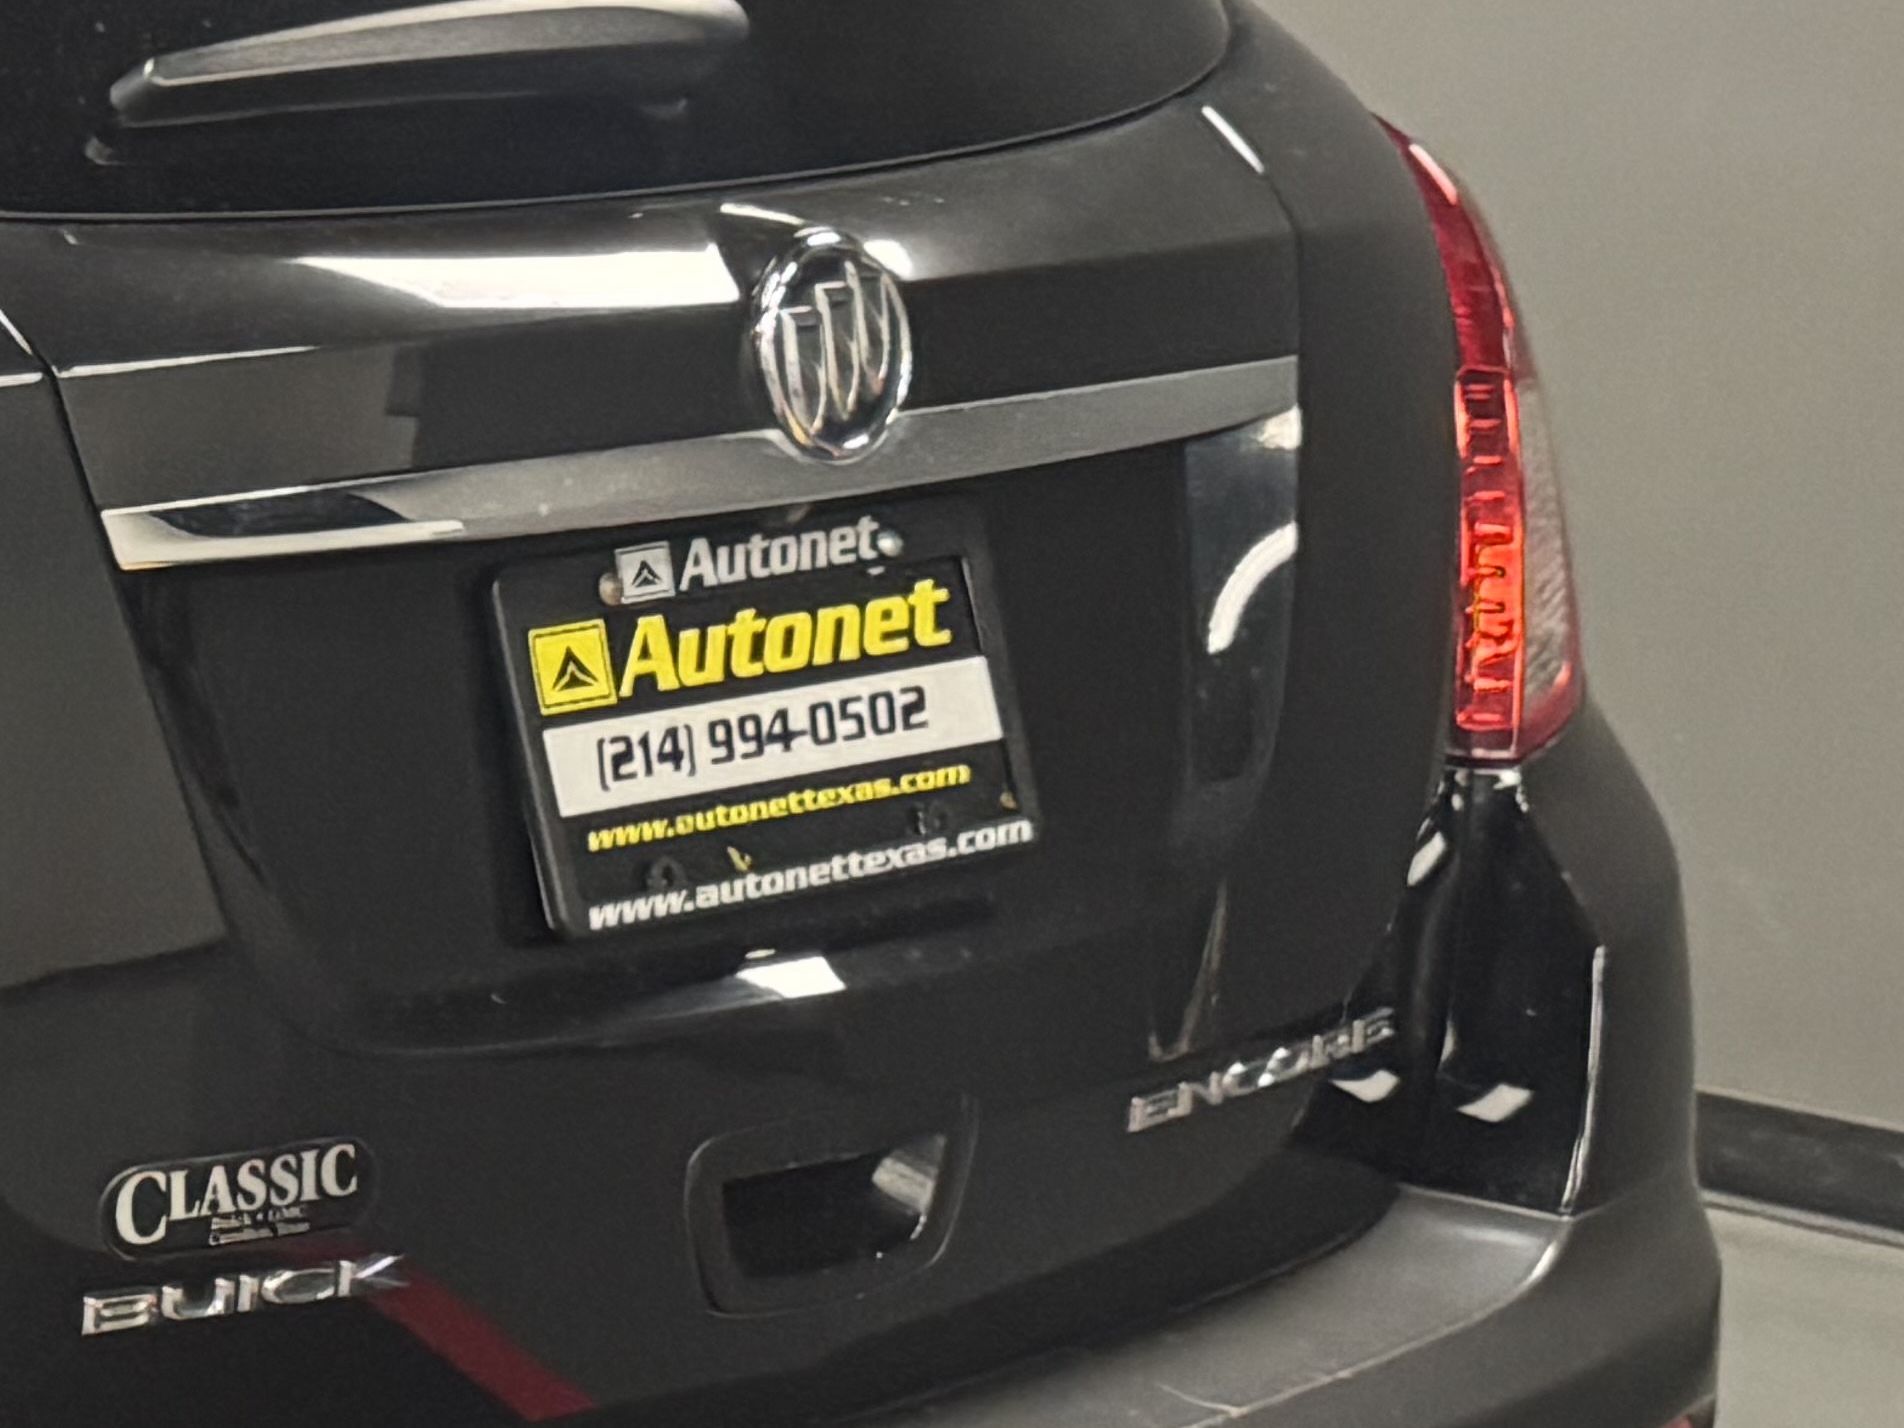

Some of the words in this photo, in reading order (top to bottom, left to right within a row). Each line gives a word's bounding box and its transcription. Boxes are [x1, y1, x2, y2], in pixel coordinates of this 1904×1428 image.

[679, 515, 879, 591] Autonet
[619, 580, 951, 697] Autonet
[597, 724, 695, 791] (214)
[708, 685, 929, 764] 994-0502
[588, 765, 971, 852] www.autonettexas.com
[589, 818, 1033, 931] www.autonettexas.com
[1128, 1007, 1395, 1133] ENCORE
[81, 1253, 410, 1335] BUICK
